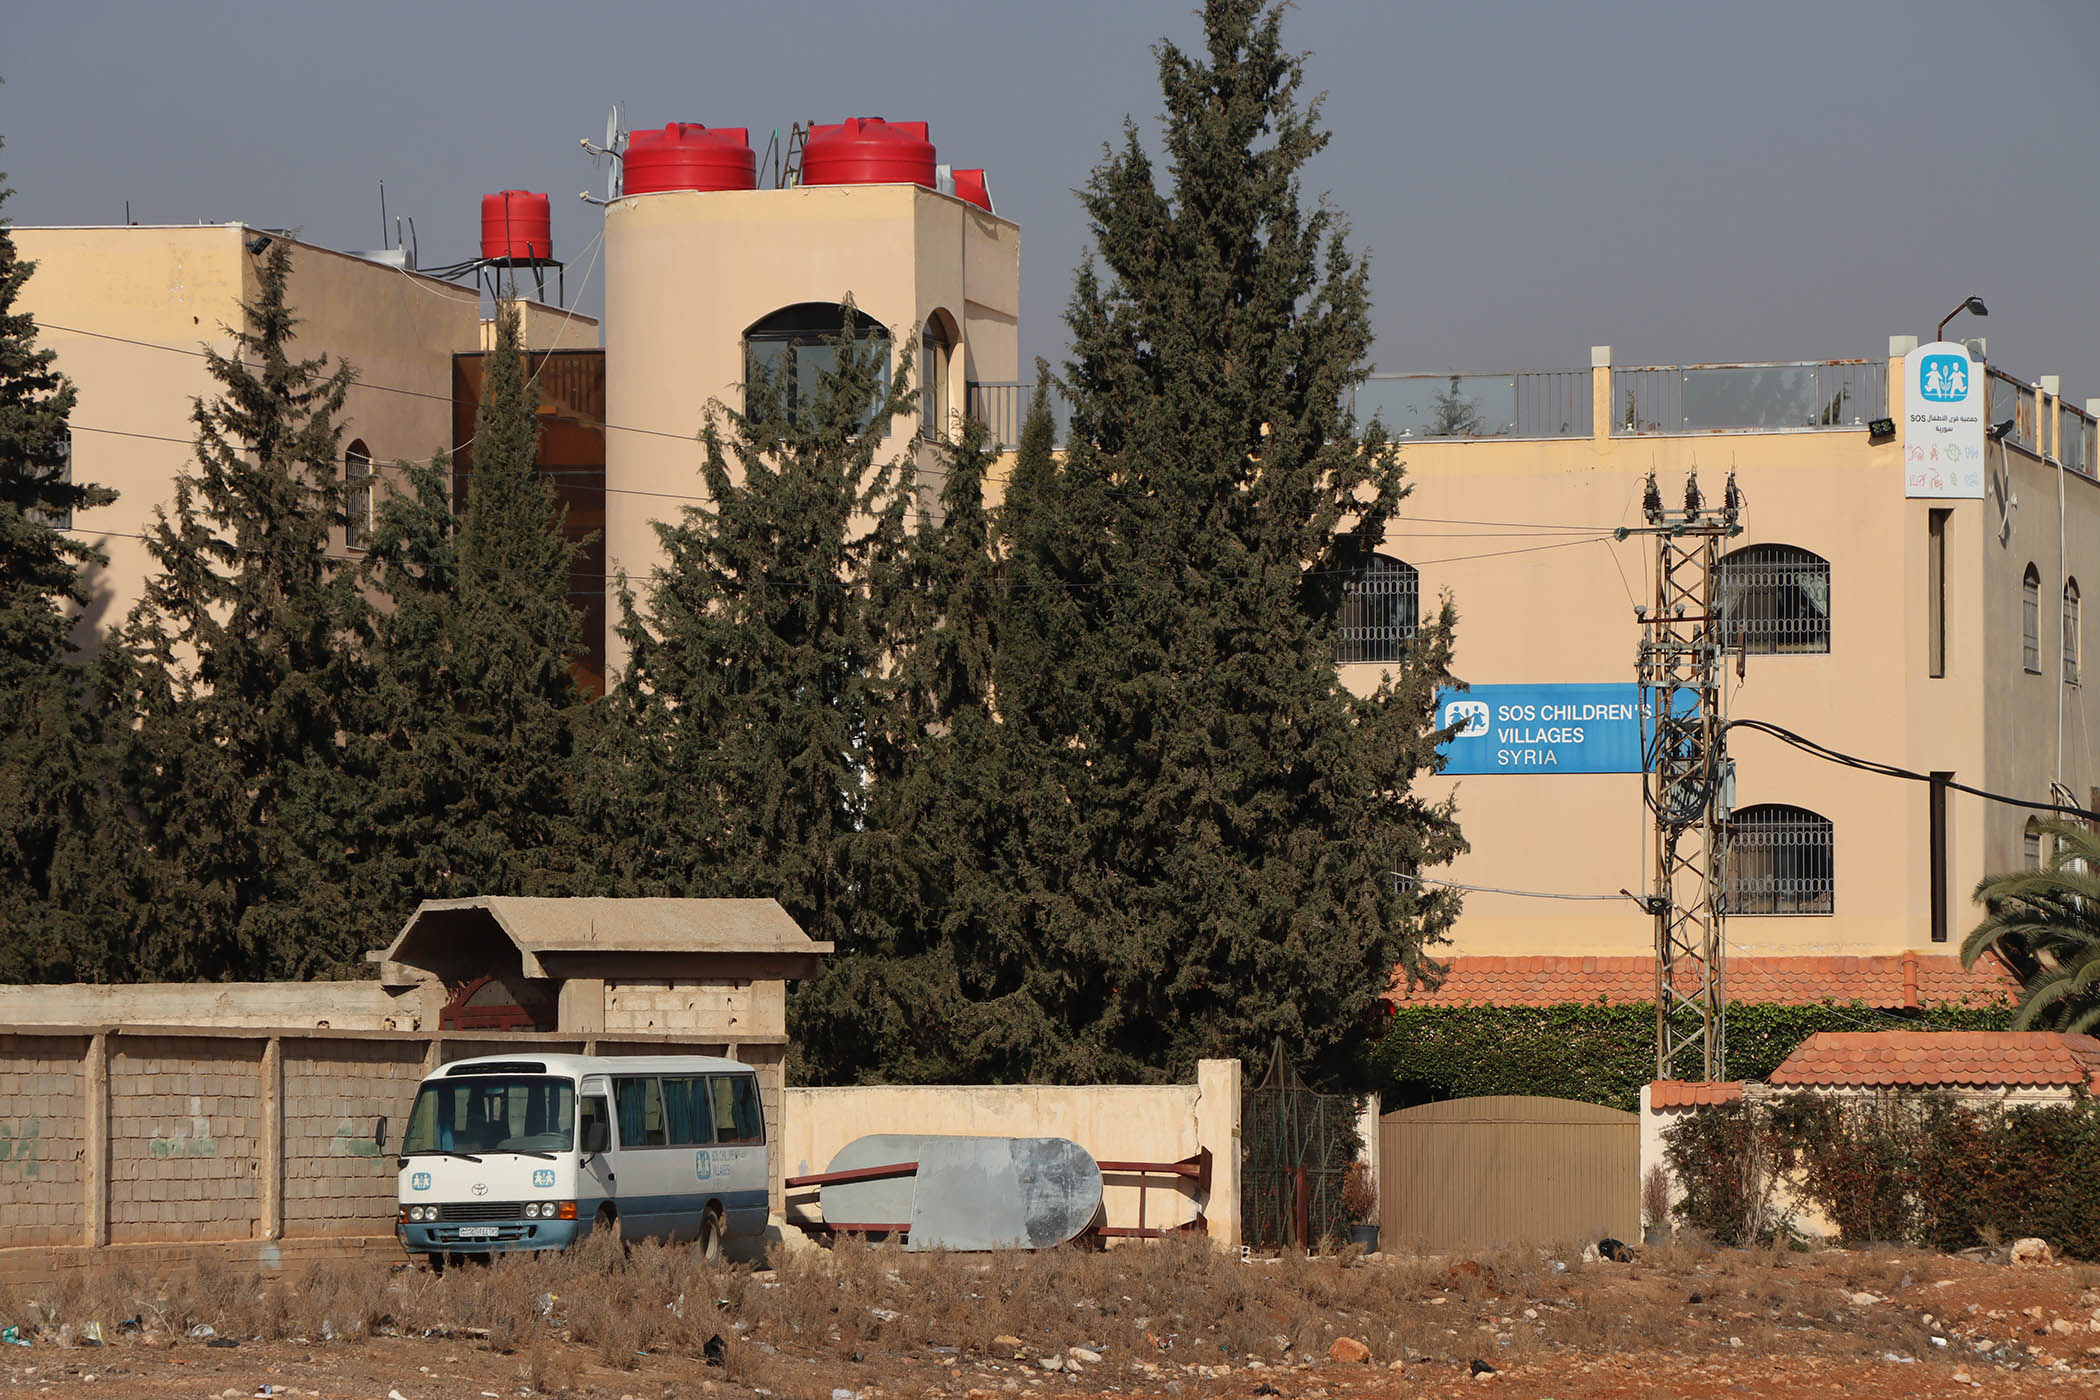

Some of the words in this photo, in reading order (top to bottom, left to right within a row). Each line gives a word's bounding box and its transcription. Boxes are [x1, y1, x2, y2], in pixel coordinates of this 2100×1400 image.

[1910, 414, 1926, 423] SOS
[1498, 704, 1536, 721] SOS
[1541, 703, 1652, 721] CHILDREN'S
[1498, 727, 1585, 744] VILLAGES
[1498, 749, 1558, 766] SYRIA
